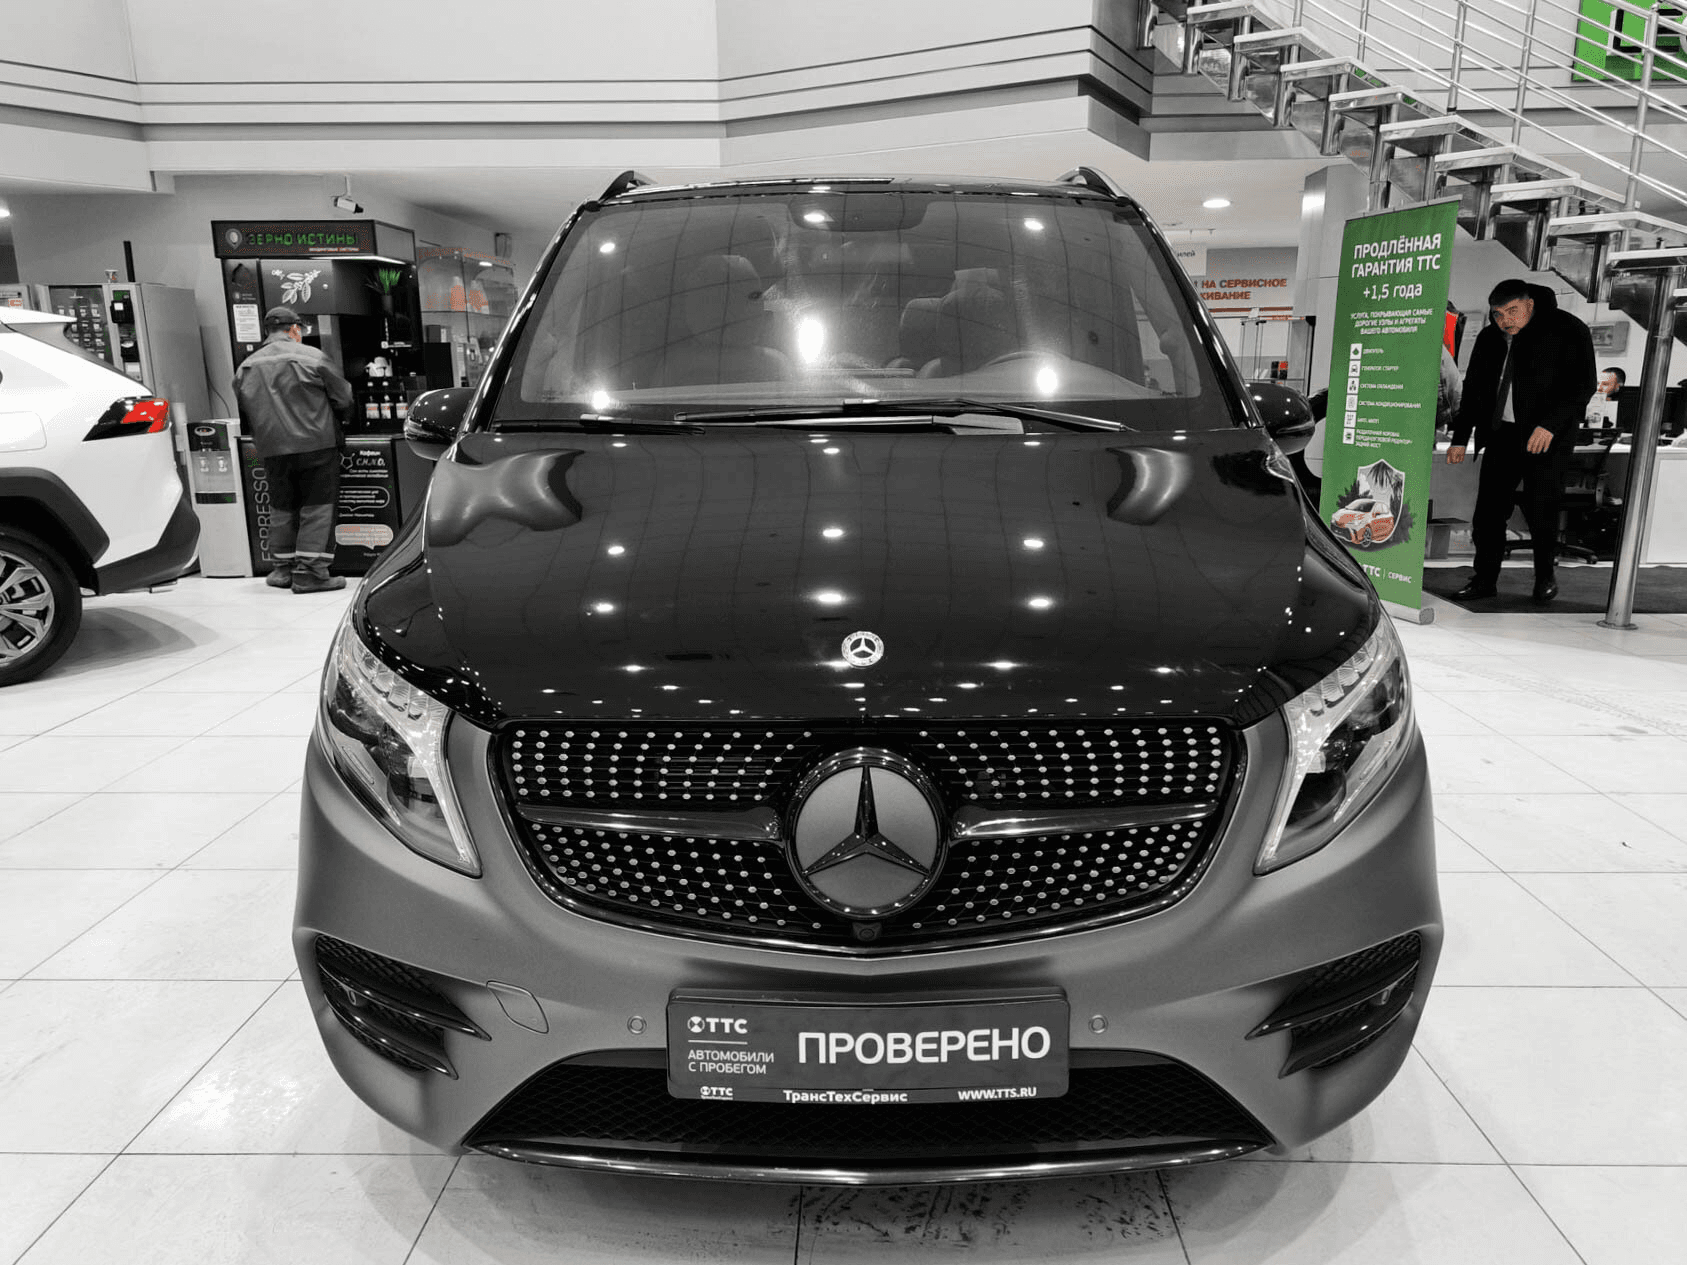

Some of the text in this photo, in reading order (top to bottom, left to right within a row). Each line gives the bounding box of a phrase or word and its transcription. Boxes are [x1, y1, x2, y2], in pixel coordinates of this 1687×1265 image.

[248, 233, 359, 246] ЗЕРНО ИСТИНЫ
[1354, 233, 1442, 259] ПРОДЛЁННАЯ
[1351, 254, 1441, 278] ГАРАНТИЯ ТТС
[1202, 280, 1217, 289] НА
[1219, 278, 1288, 289] СЕРВИСНОЕ
[1363, 283, 1423, 301] +1,5 года
[1362, 564, 1412, 584] ТТС СЕРВИС
[705, 1017, 748, 1034] ТТС
[798, 1026, 1051, 1065] ПРОВЕРЕНО
[687, 1049, 775, 1063] АВТОМОБИЛИ
[688, 1061, 767, 1075] С ПРОБЕГОМ
[711, 1086, 733, 1096] ТТС
[783, 1088, 908, 1104] ТрансТехСервис
[958, 1087, 1037, 1101] WWW.TTS.RU
